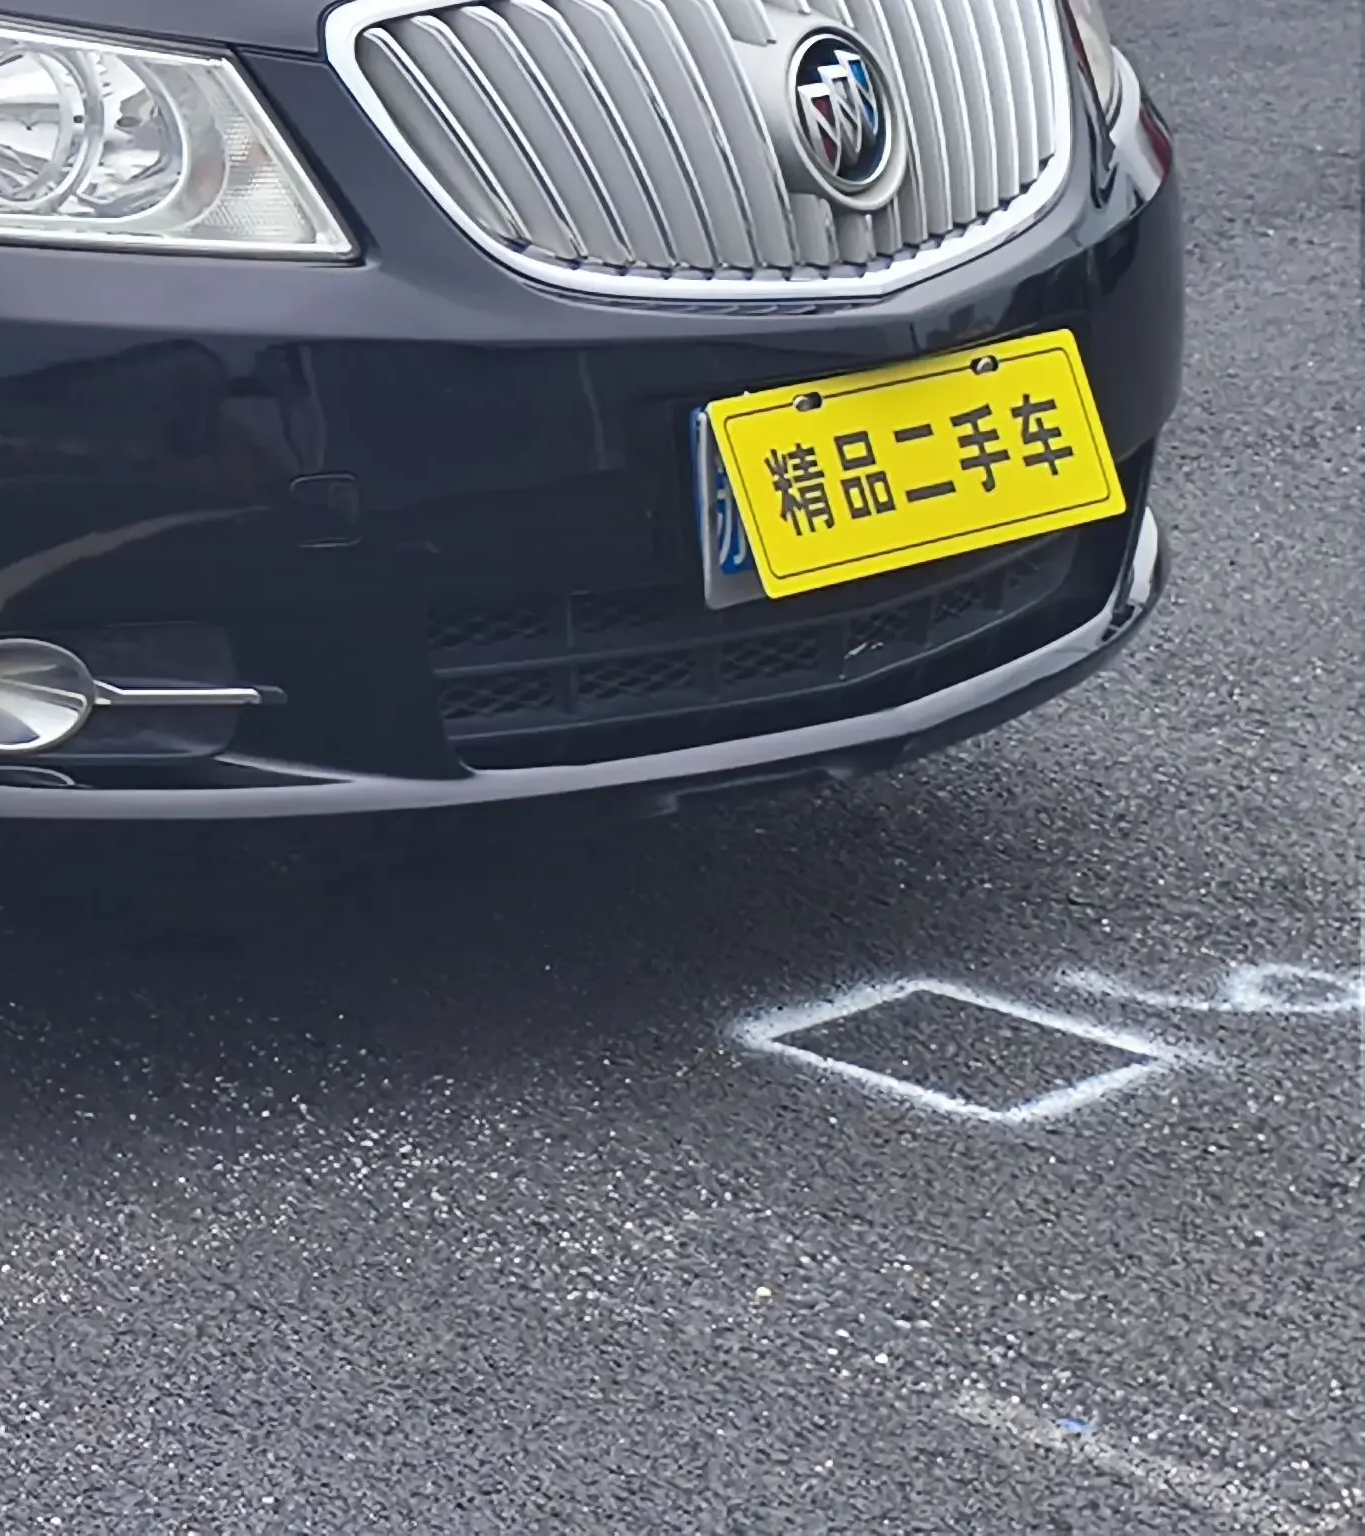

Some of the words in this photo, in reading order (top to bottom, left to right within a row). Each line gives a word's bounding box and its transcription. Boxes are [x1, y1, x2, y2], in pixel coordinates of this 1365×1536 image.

[764, 394, 1074, 537] 精品二手车
